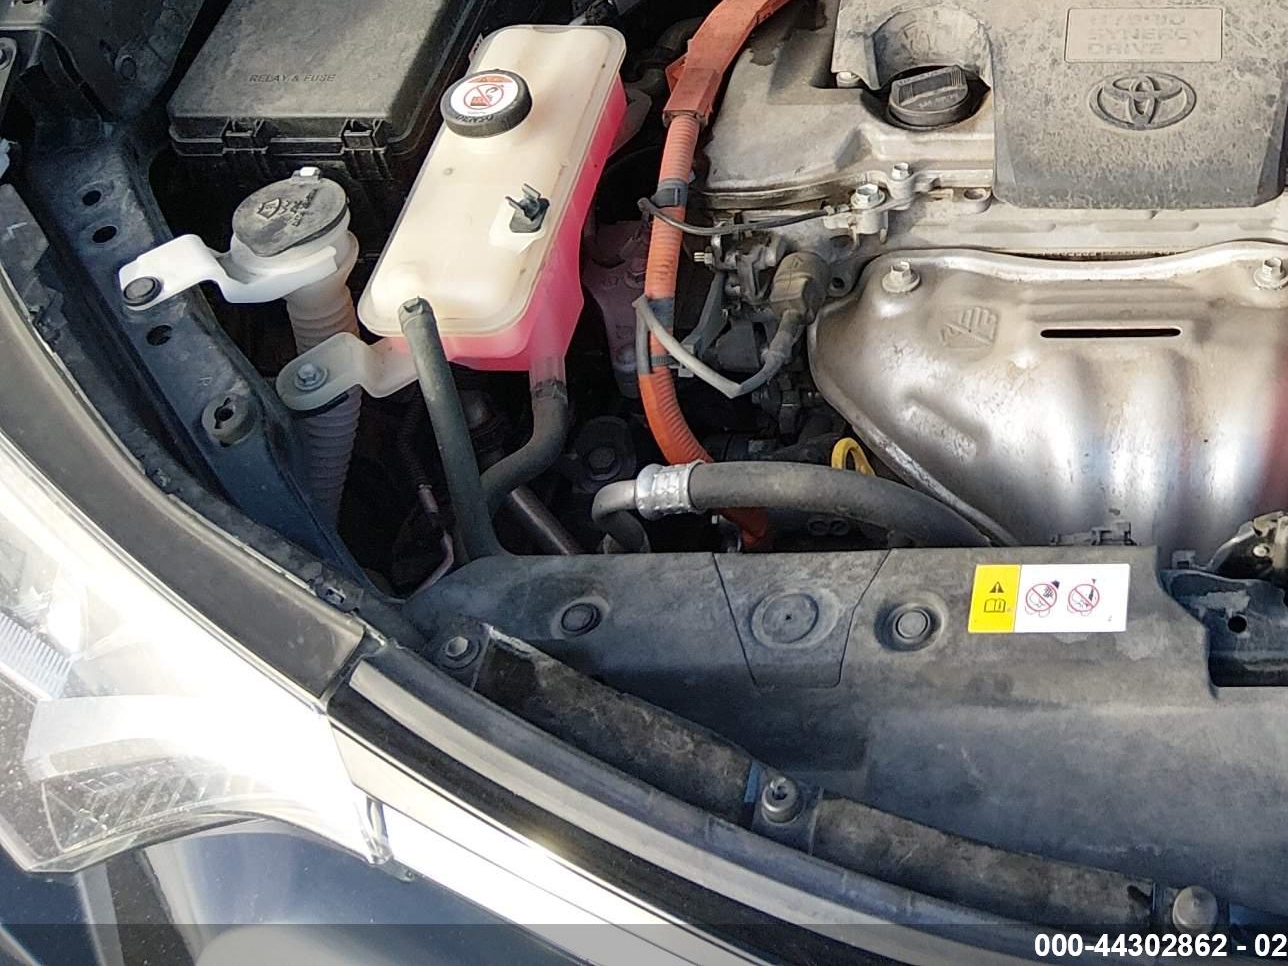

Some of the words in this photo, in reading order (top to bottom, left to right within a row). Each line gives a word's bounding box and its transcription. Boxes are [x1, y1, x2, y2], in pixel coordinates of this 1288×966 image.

[1087, 28, 1206, 40] SYNERGY
[1087, 42, 1164, 55] DRIVE
[248, 73, 289, 83] RELAY
[302, 73, 337, 83] FUSE
